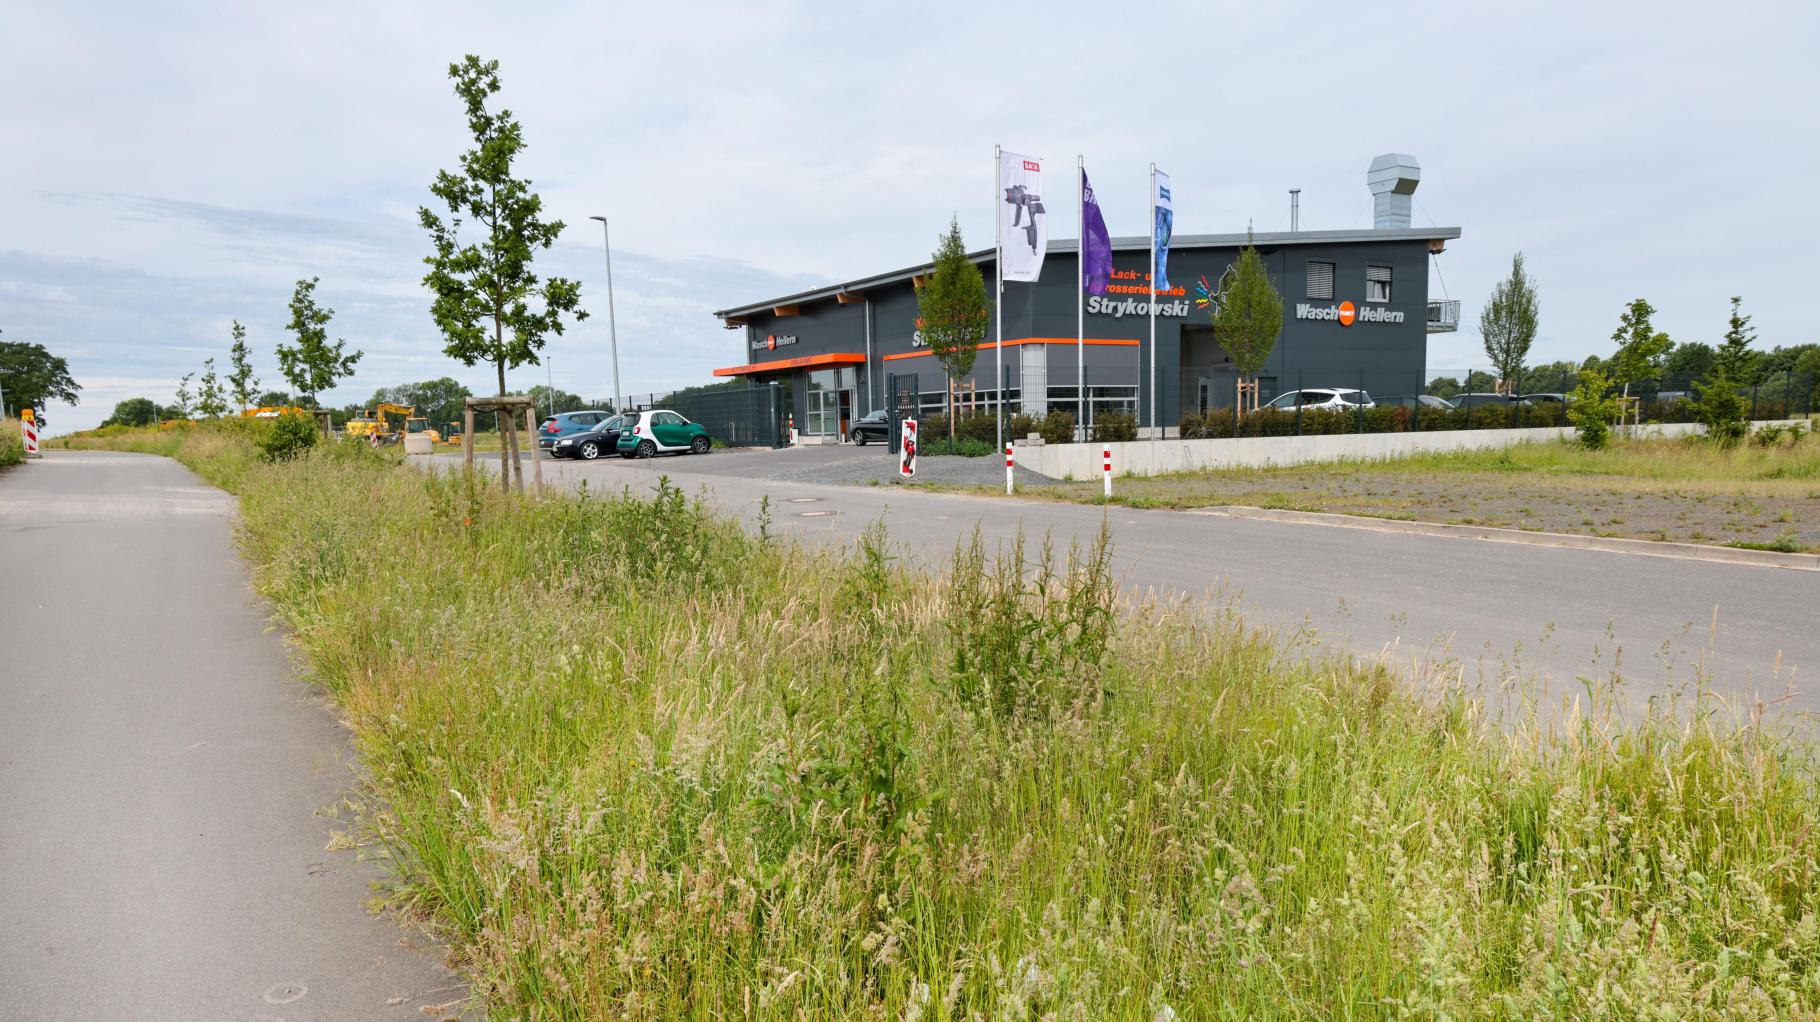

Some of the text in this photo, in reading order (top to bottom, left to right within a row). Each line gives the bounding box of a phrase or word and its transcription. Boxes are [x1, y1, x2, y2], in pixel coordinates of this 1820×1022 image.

[1110, 268, 1141, 279] Lack-
[1087, 296, 1189, 317] Strykowski
[1296, 304, 1340, 320] Wasch
[1359, 307, 1404, 322] Hellern
